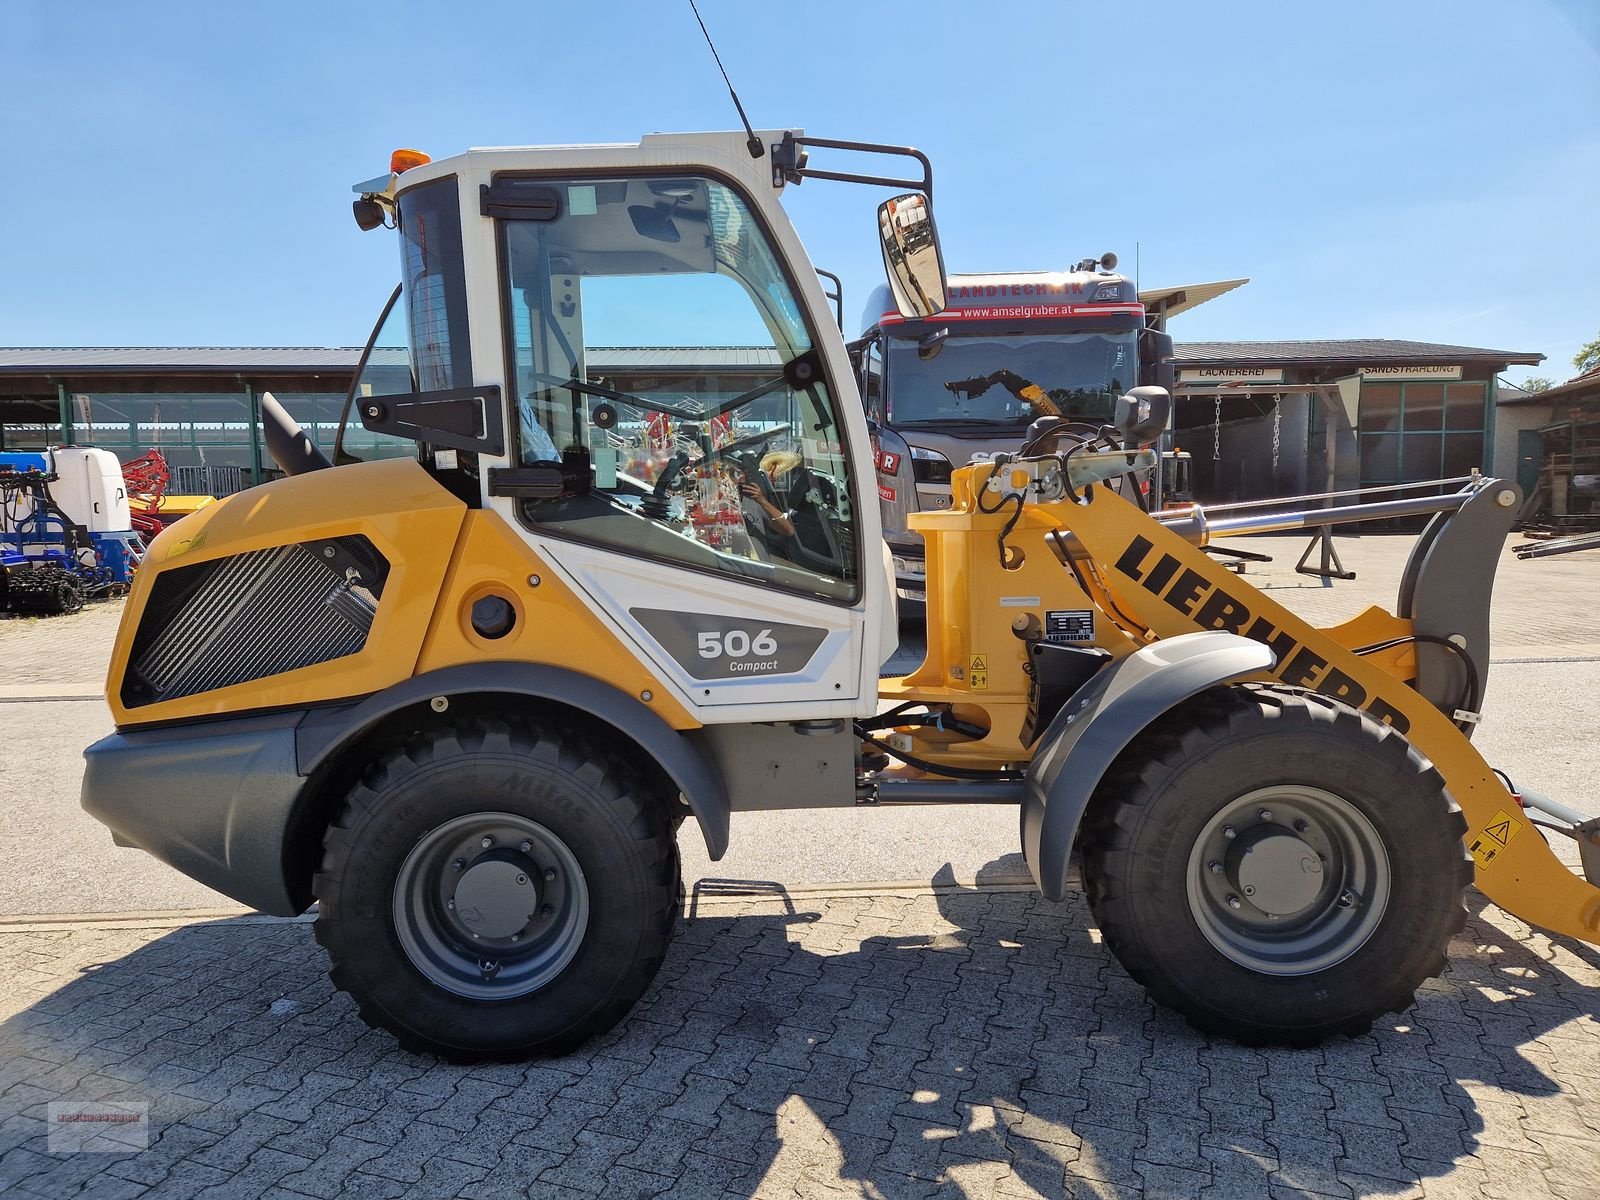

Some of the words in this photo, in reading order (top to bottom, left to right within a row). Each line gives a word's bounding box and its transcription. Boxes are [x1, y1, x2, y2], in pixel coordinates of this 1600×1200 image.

[963, 304, 1073, 319] www.amselgruber.at
[1199, 368, 1266, 377] LACKIEREREI
[1364, 365, 1455, 375] SANDSTRAHLUNG
[696, 628, 778, 659] 506
[729, 659, 779, 673] Compact
